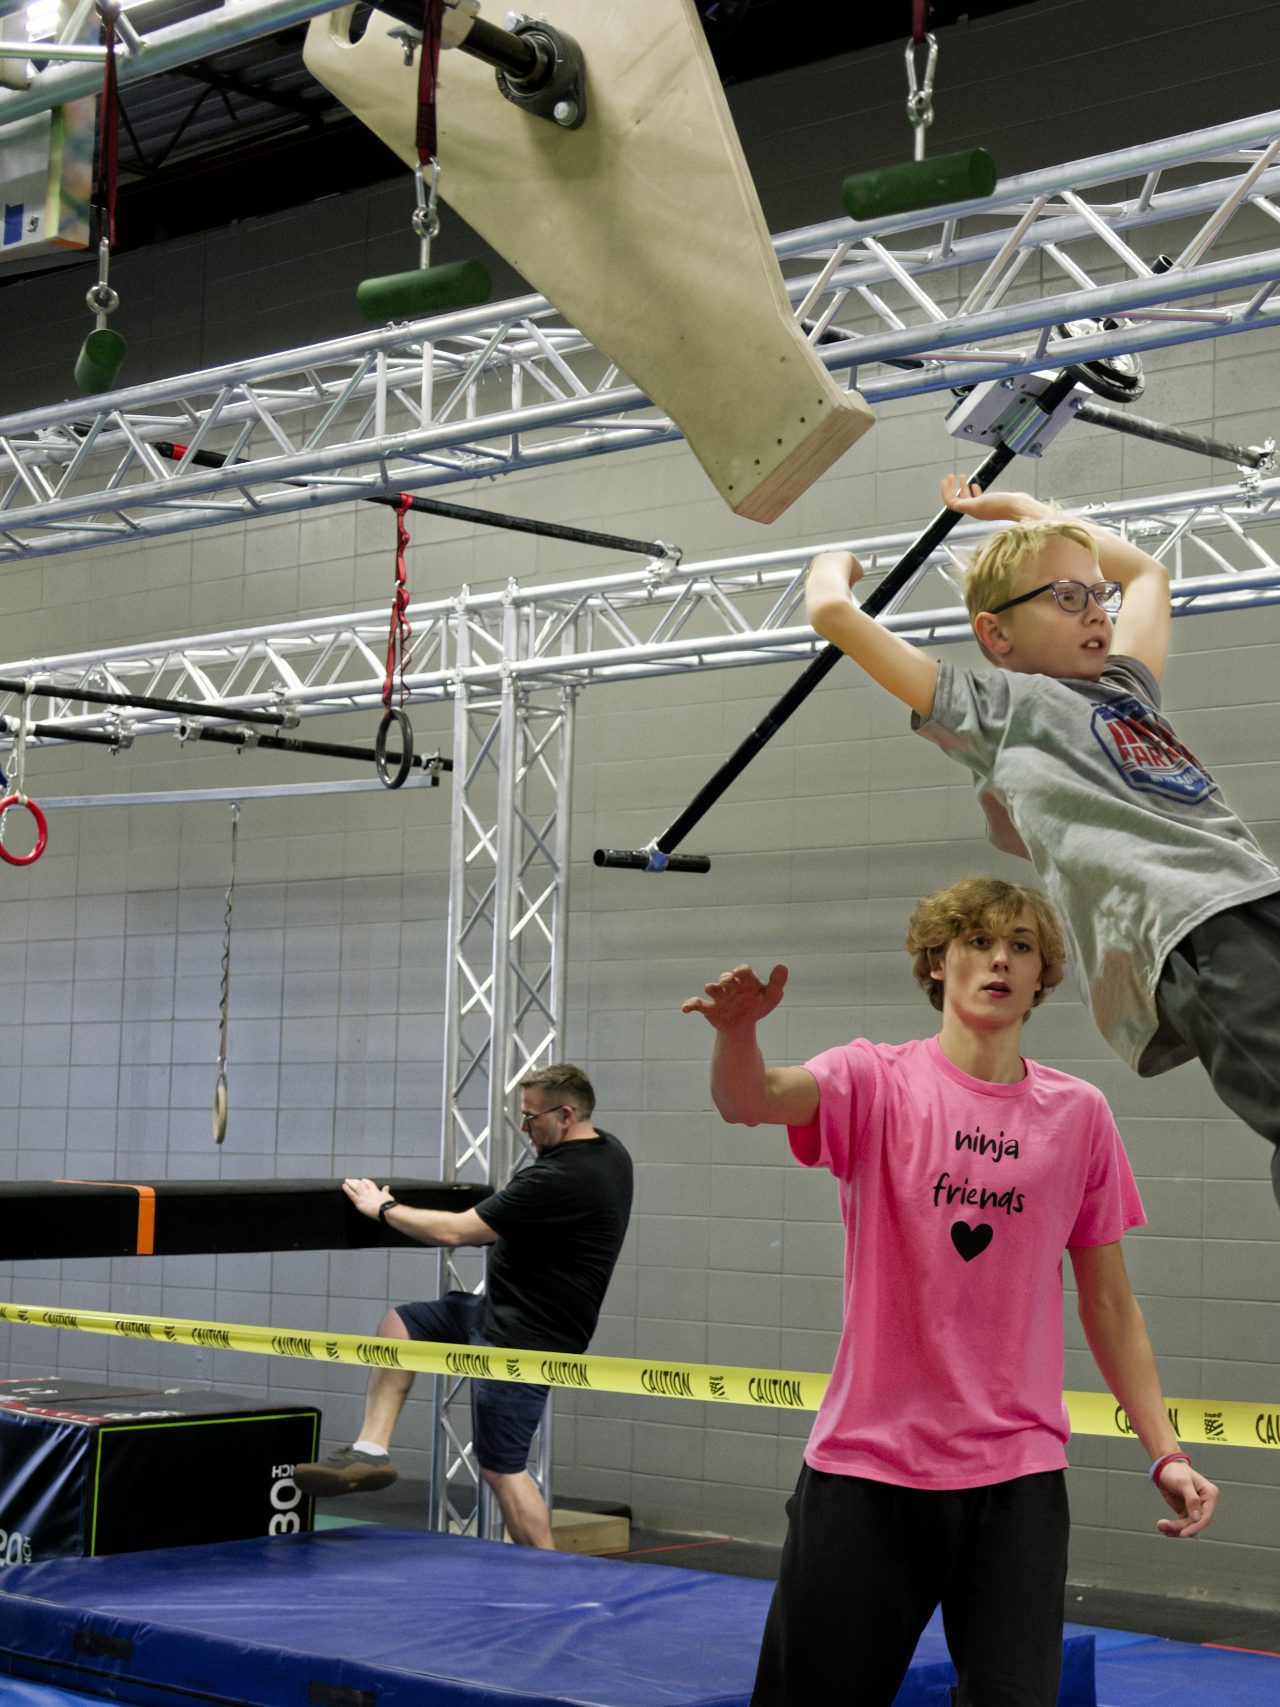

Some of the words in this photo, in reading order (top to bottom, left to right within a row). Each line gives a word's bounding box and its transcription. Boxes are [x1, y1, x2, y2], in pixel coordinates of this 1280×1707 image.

[955, 1126, 1019, 1163] ninja
[933, 1172, 1026, 1215] friends
[272, 1336, 315, 1358] CAUTION
[357, 1344, 403, 1368] CAUTION
[446, 1352, 494, 1377] CAUTION
[541, 1360, 592, 1387] CAUTION
[641, 1369, 694, 1397] CAUTION
[748, 1378, 804, 1407] CAUTION
